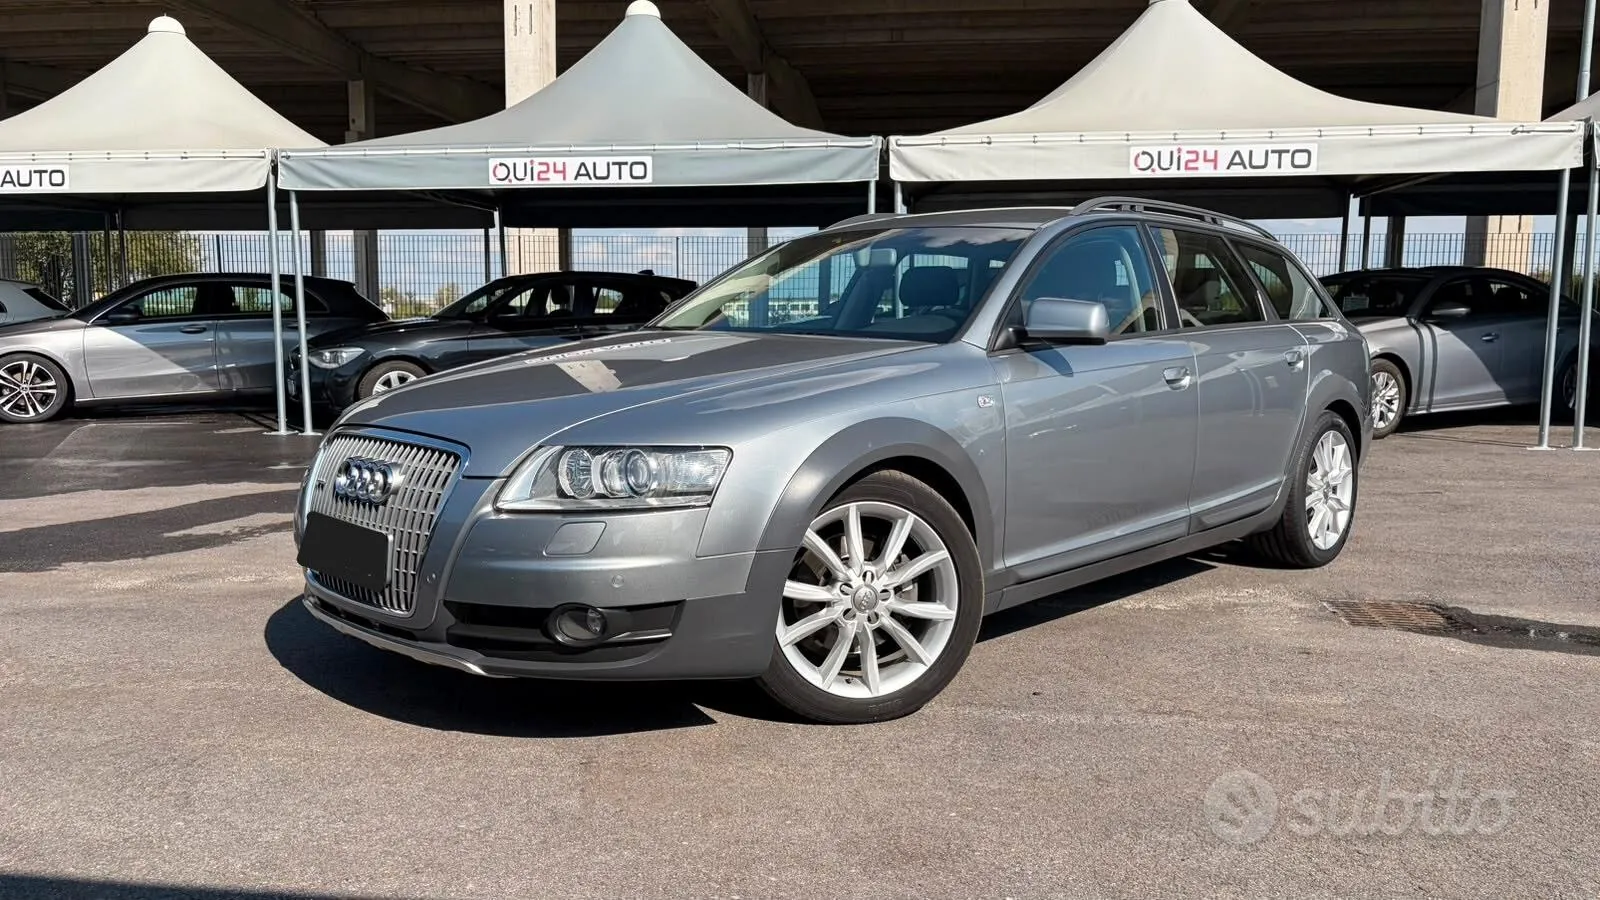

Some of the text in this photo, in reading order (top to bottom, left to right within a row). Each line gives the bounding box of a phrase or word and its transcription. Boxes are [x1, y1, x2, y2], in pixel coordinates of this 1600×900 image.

[1226, 149, 1312, 170] AUTO
[0, 169, 65, 188] AUTO
[574, 161, 648, 181] AUTO
